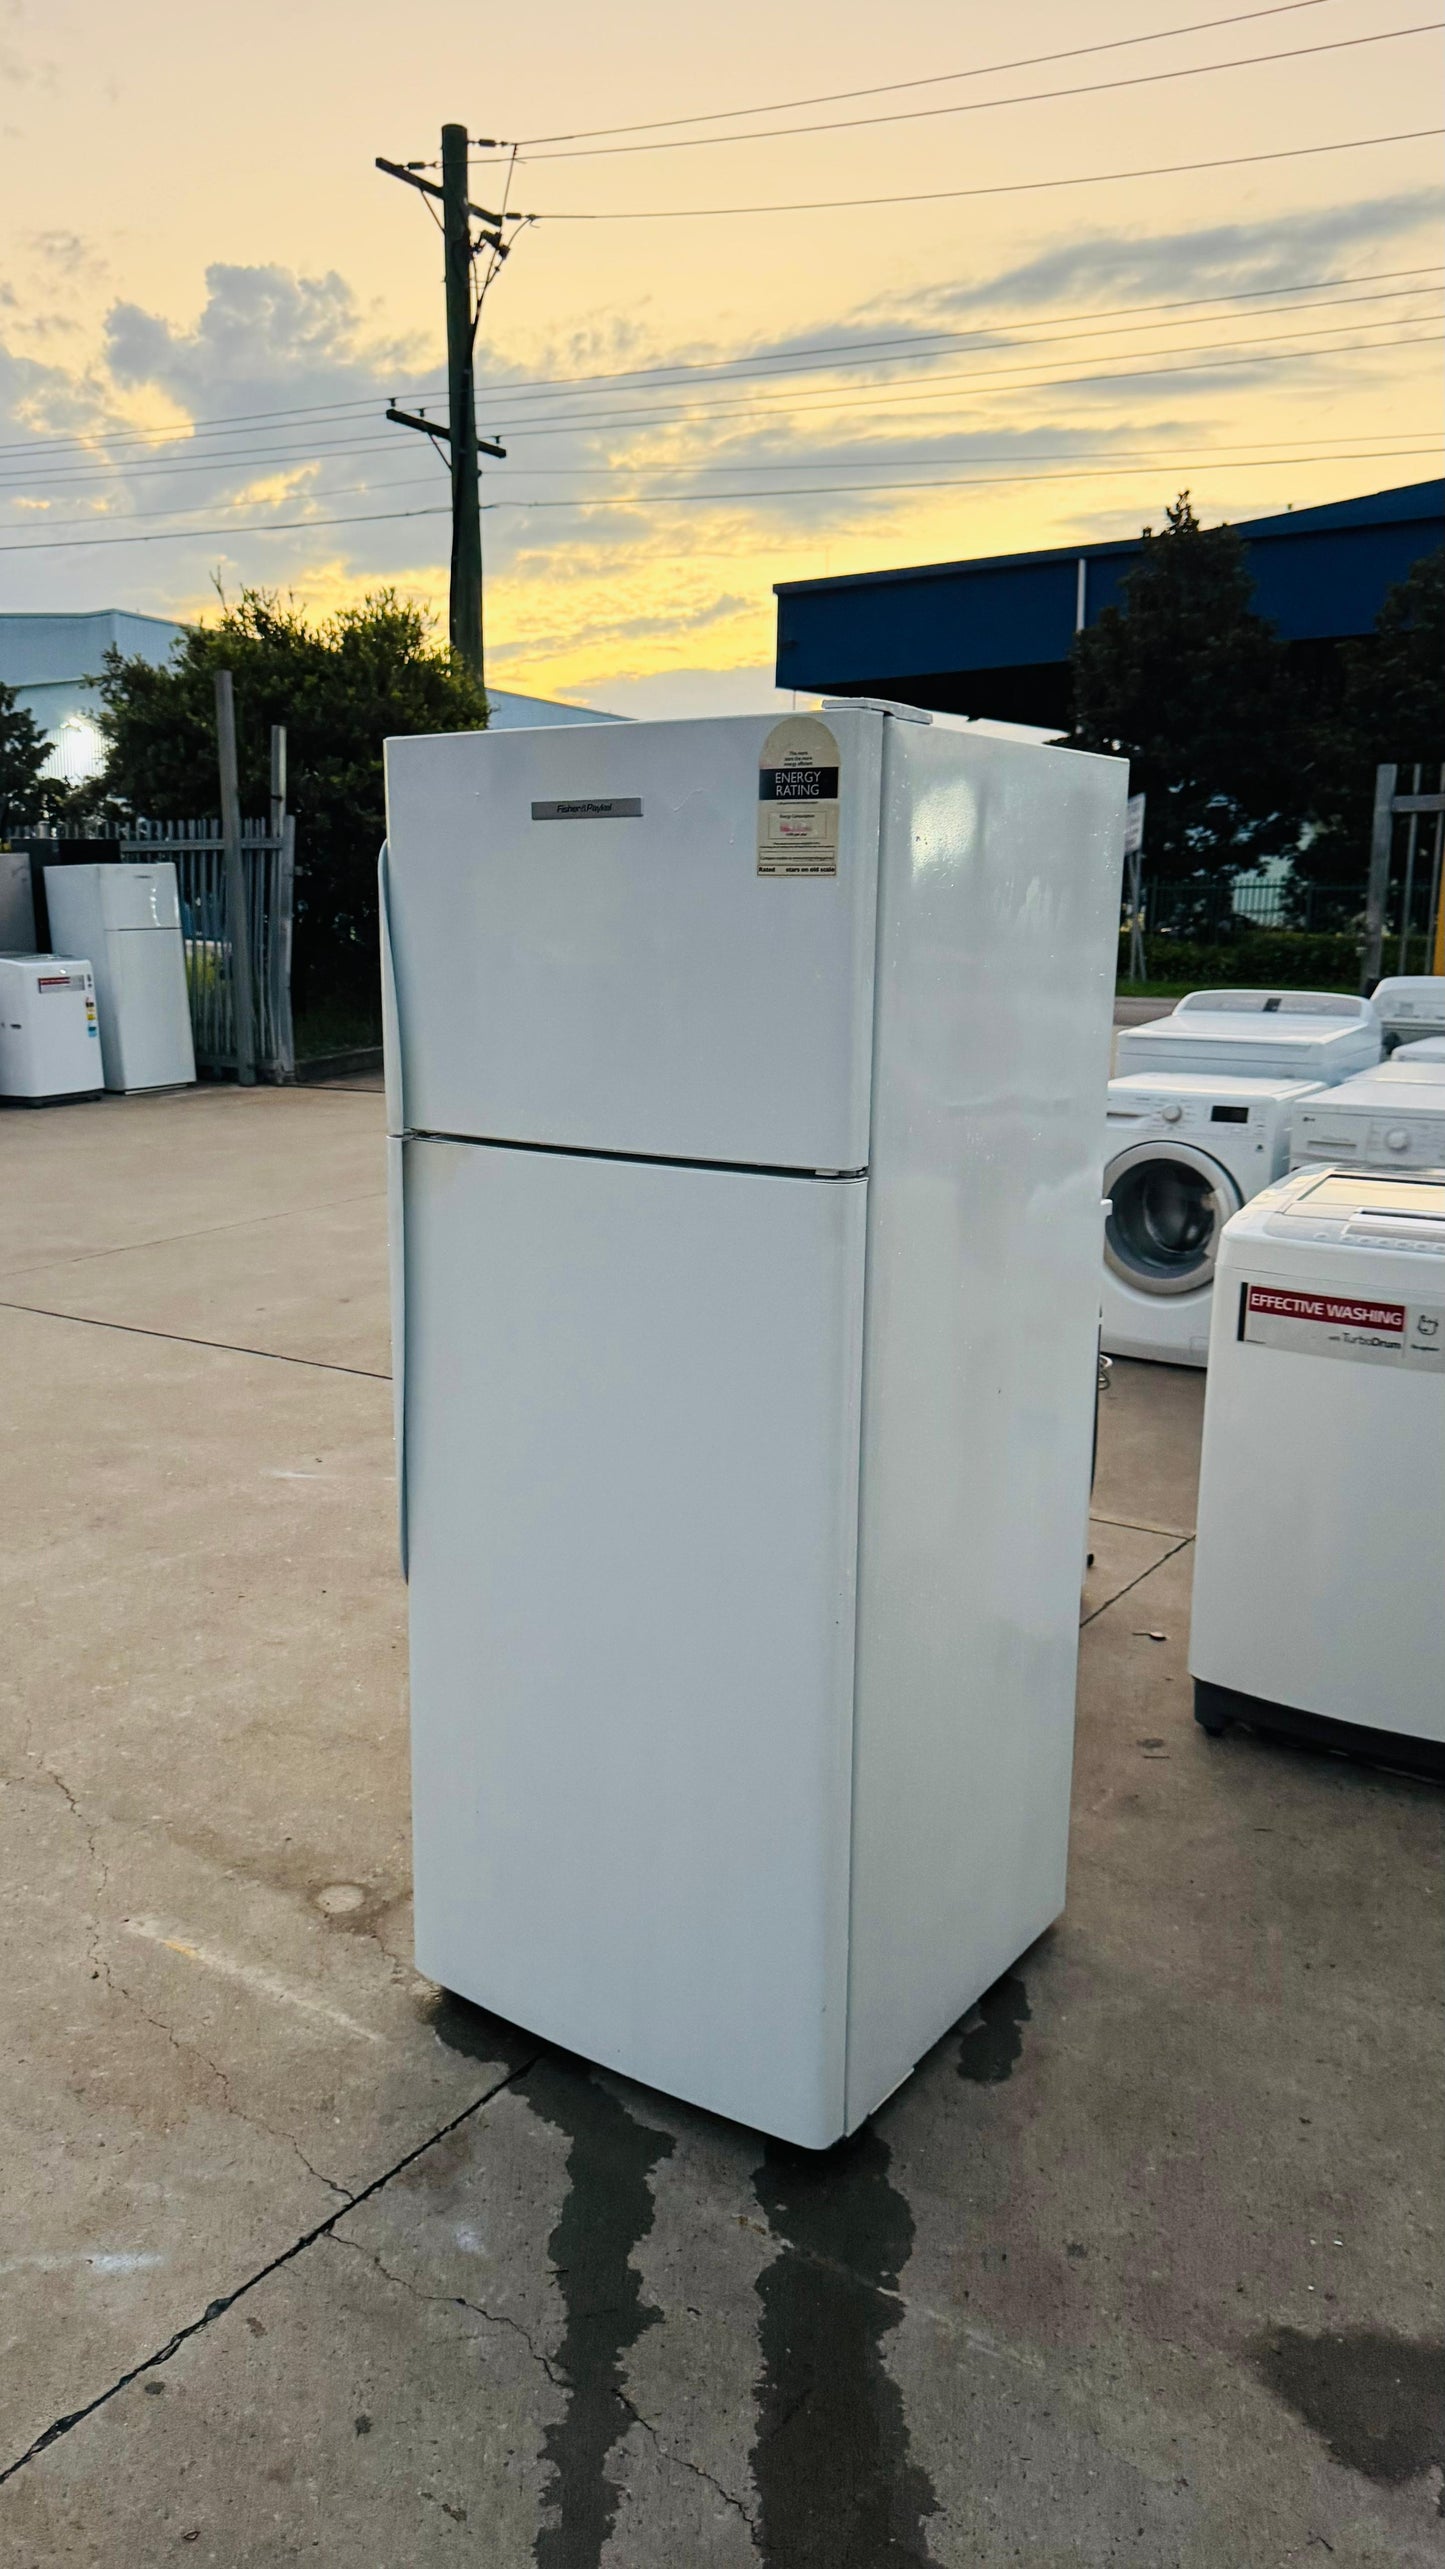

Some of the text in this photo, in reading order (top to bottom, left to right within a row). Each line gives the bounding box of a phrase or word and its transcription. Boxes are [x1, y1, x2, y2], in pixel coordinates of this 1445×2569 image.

[775, 771, 821, 783] ENERGY
[776, 784, 819, 796] RATING
[1251, 1293, 1402, 1325] EFFECTIVE WASHING
[1342, 1332, 1402, 1349] TurboDrum
